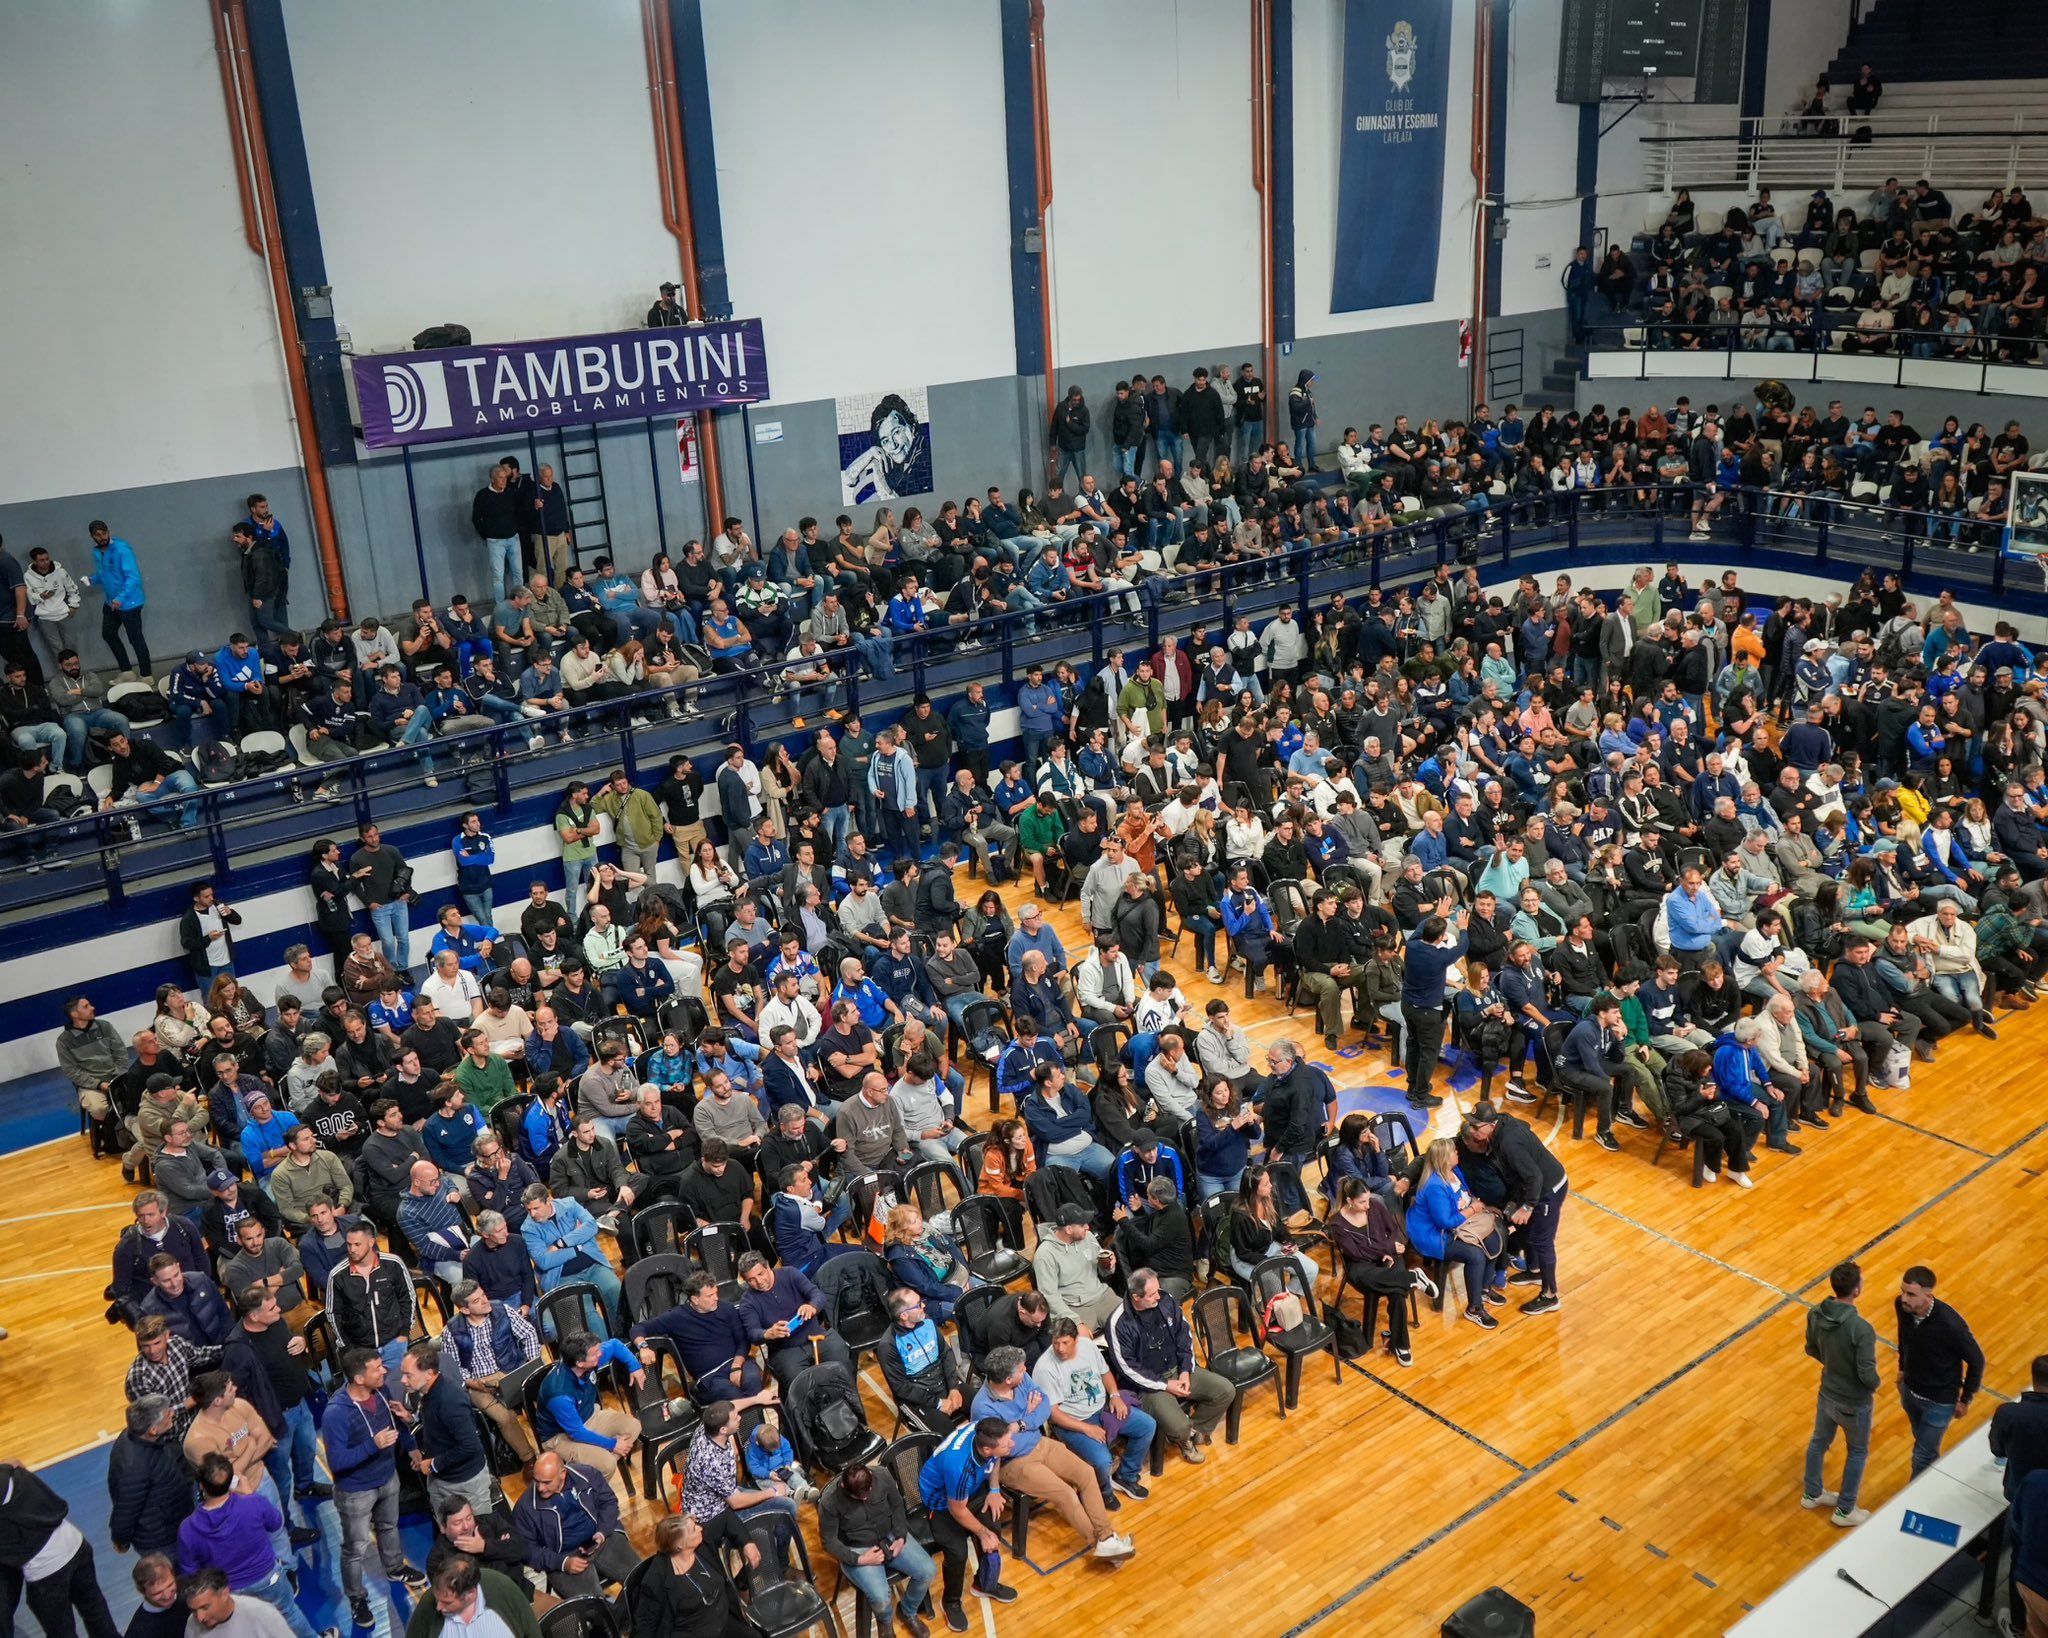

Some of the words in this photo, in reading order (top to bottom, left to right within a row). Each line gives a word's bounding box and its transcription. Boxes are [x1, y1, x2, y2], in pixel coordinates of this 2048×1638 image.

[1385, 99, 1404, 112] CLUB
[1404, 99, 1414, 111] DE
[1356, 114, 1396, 131] GIMNASIA
[1397, 114, 1404, 129] Y
[1404, 113, 1439, 129] ESGRIMA
[1383, 132, 1392, 144] LA
[1392, 131, 1413, 144] PLATA
[453, 332, 748, 407] TAMBURINI
[475, 379, 749, 426] AMOBLAMIENTOS
[1593, 827, 1614, 843] GAP
